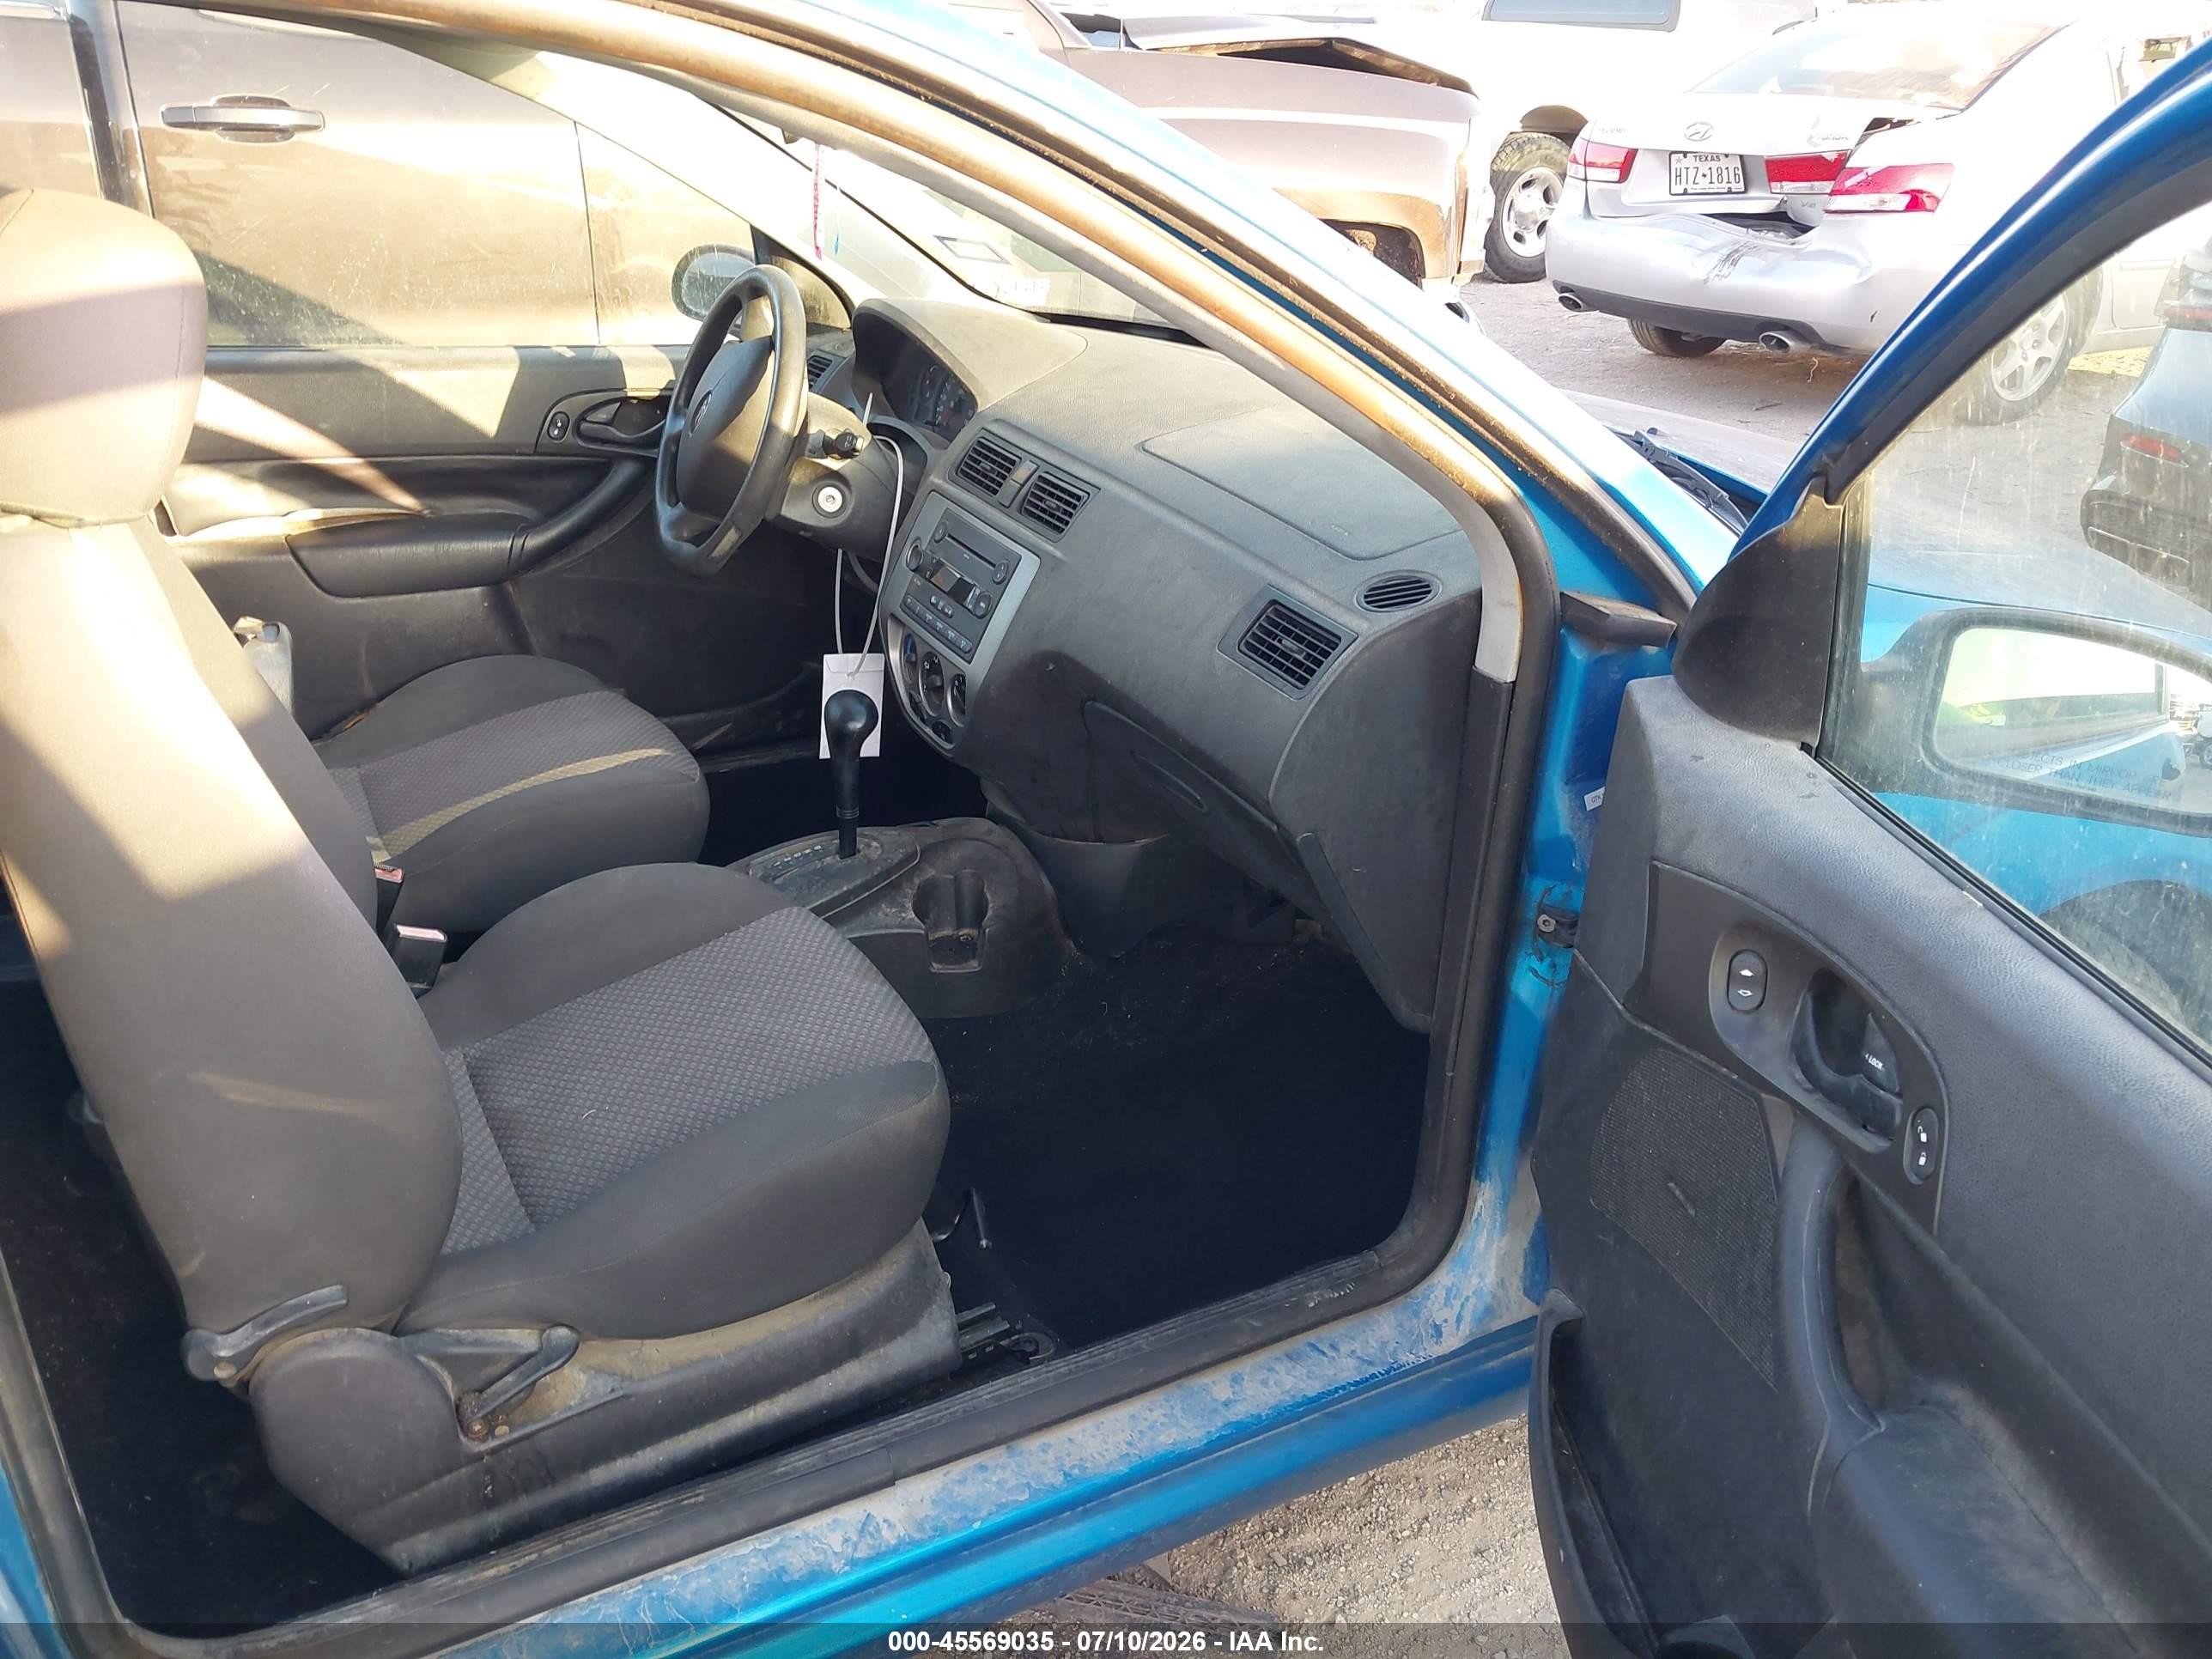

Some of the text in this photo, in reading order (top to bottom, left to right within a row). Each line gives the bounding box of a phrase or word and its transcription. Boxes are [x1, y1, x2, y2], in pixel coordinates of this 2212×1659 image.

[1708, 166, 1741, 185] 1816
[2048, 768, 2082, 782] THAN
[1869, 1054, 1883, 1070] LOCK
